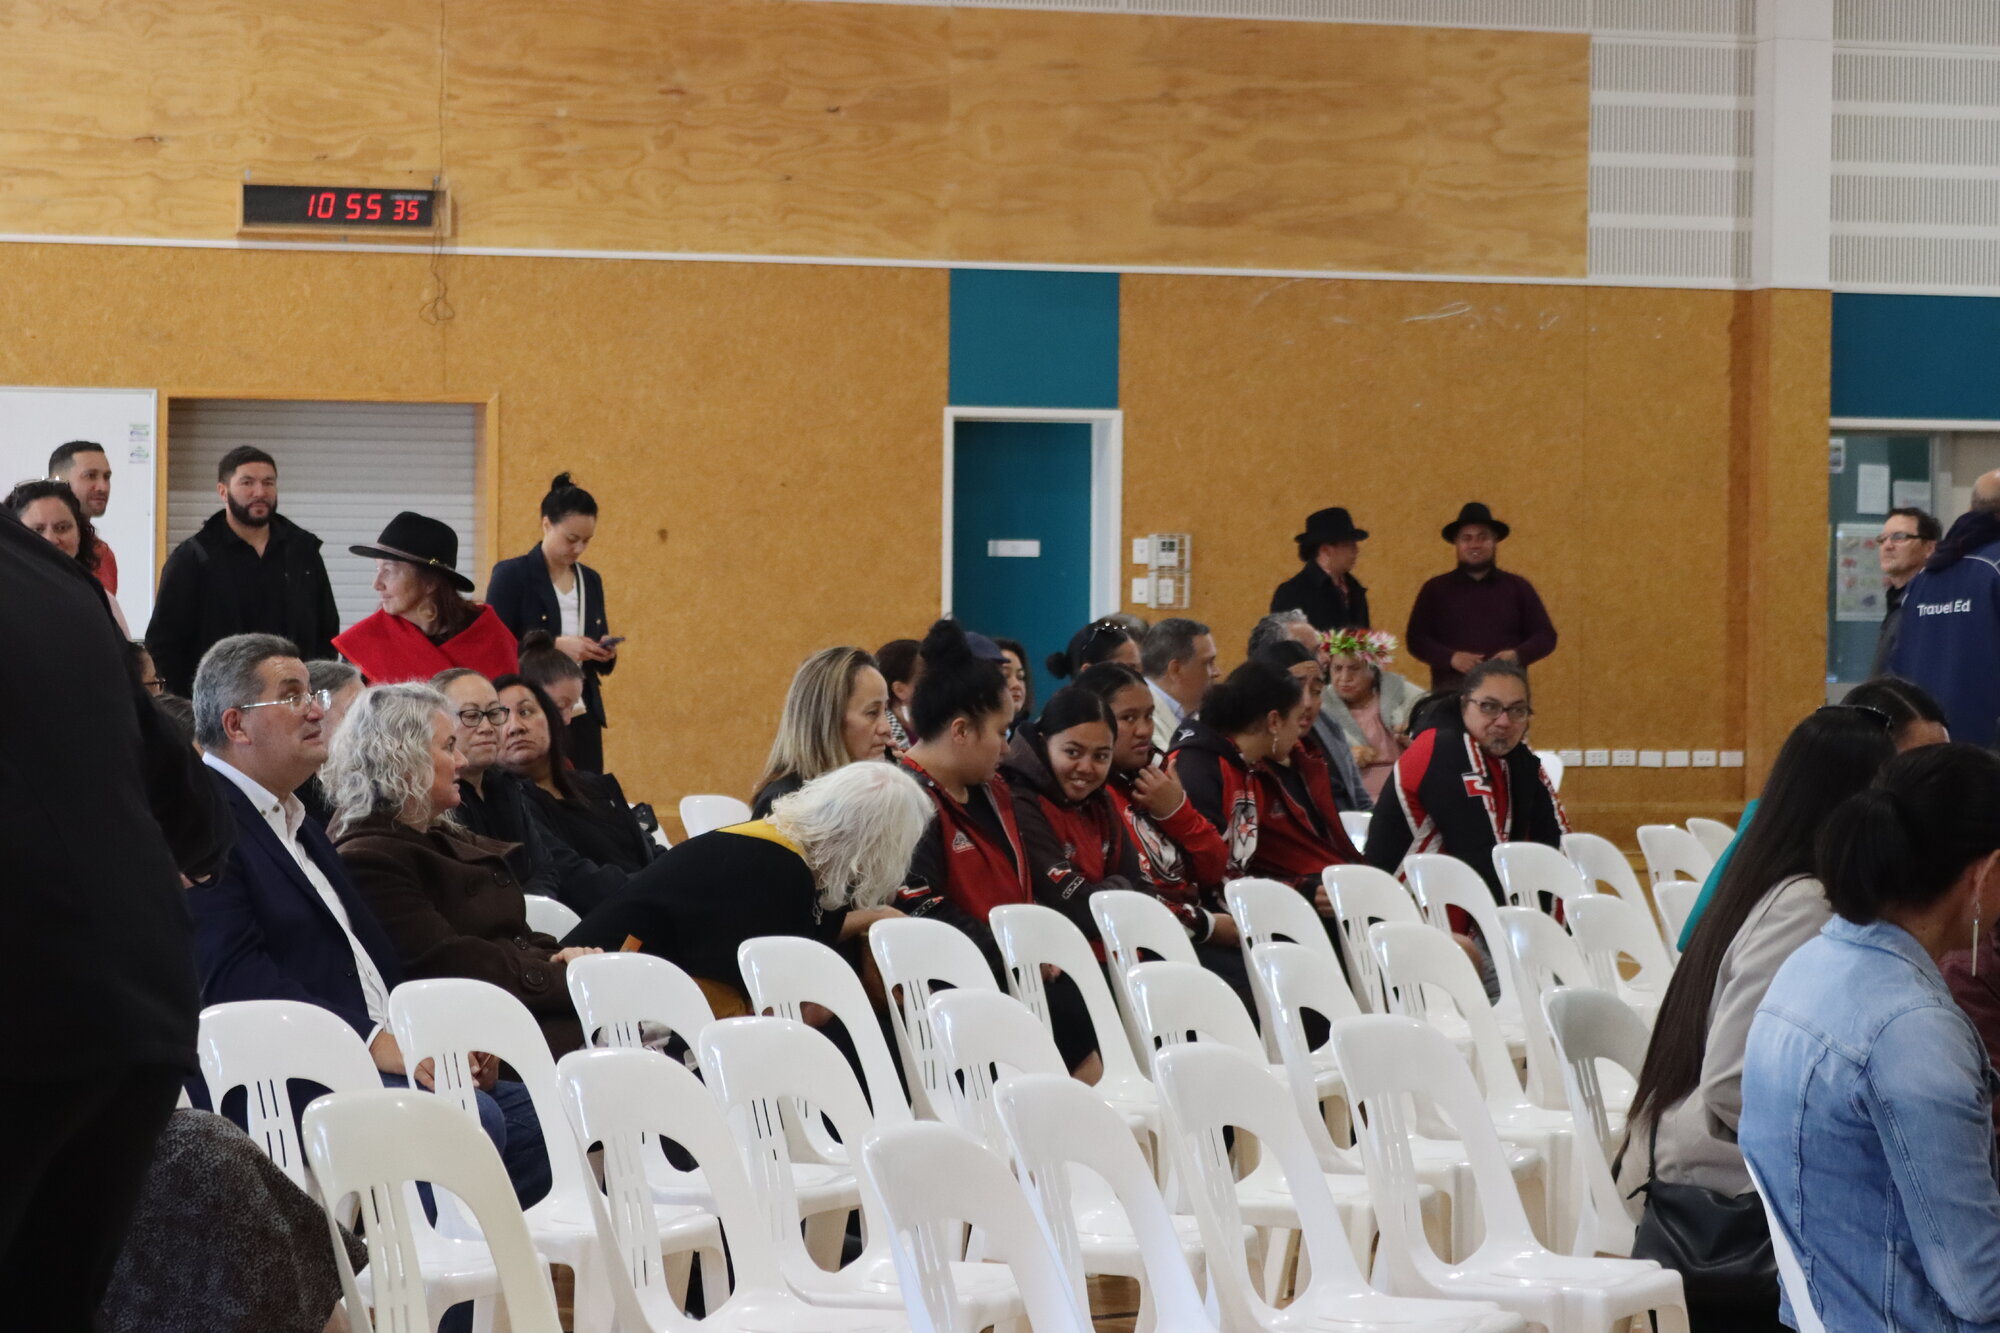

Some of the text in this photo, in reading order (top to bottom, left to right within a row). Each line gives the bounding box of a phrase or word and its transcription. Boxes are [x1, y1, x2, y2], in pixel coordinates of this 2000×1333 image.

[307, 192, 419, 220] 10 55 35
[1954, 599, 1971, 613] Ed
